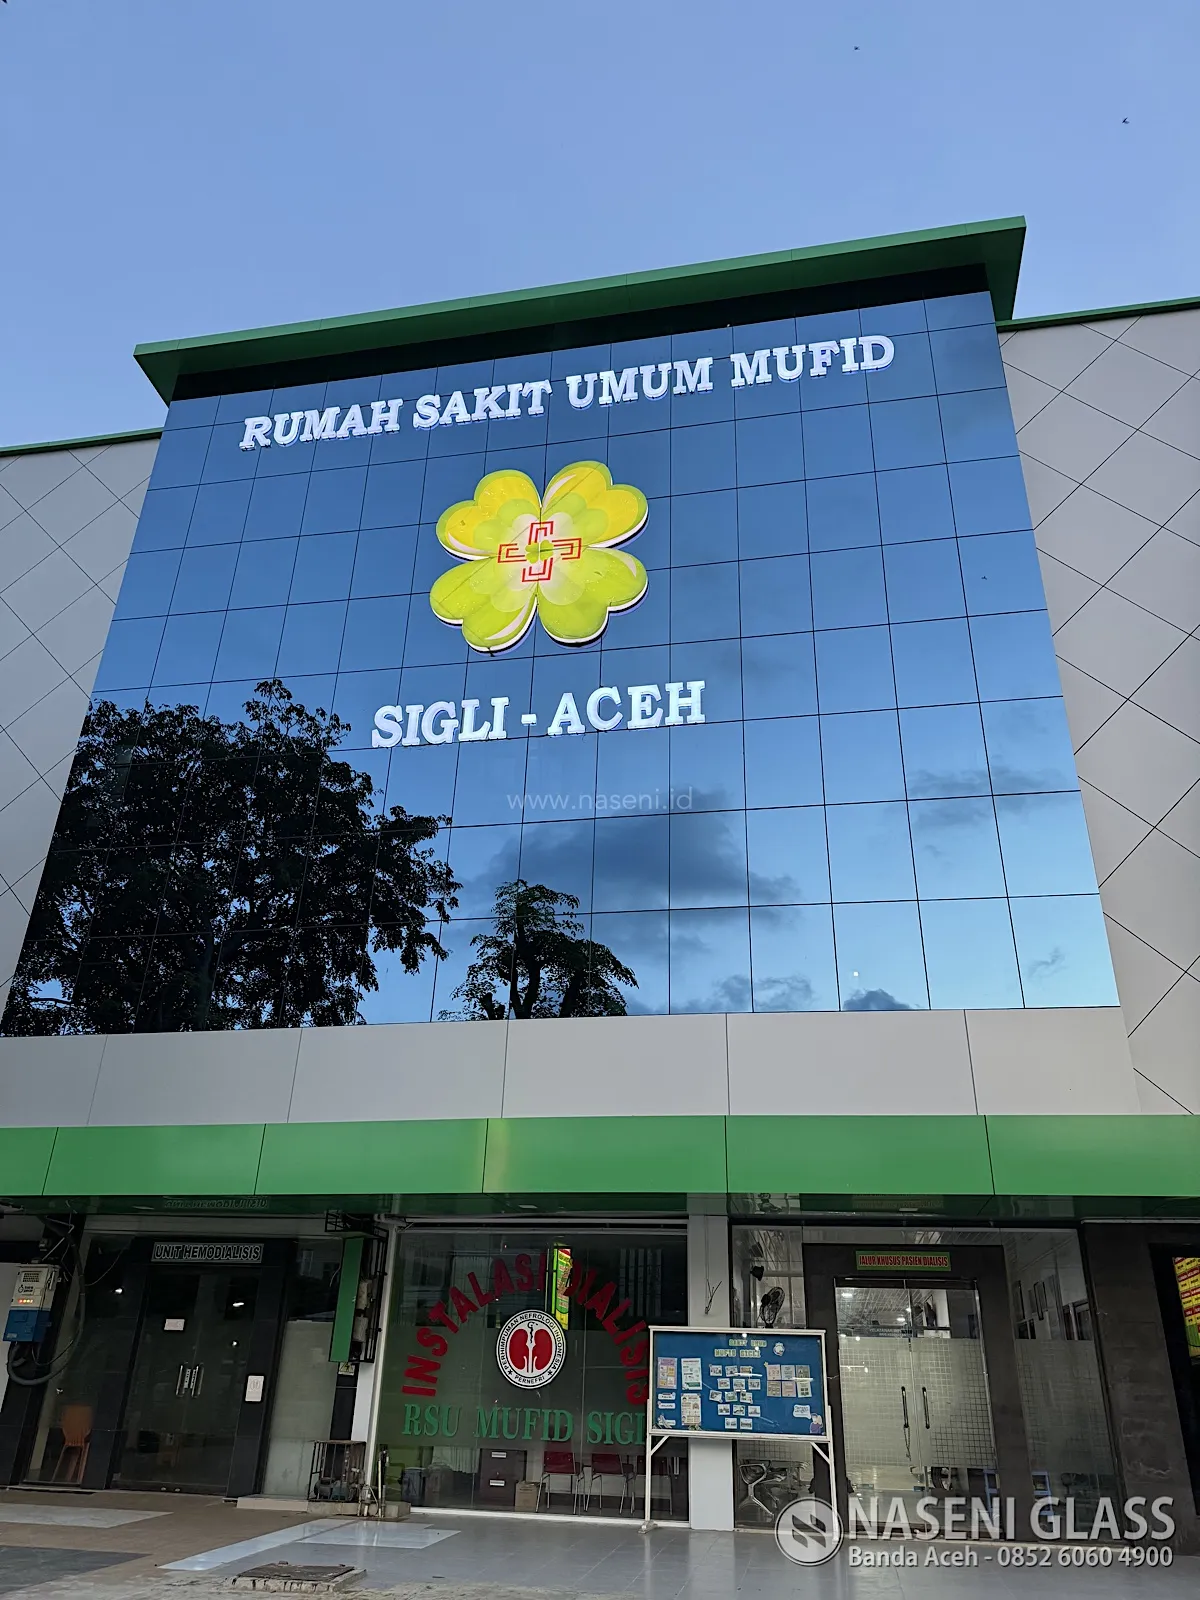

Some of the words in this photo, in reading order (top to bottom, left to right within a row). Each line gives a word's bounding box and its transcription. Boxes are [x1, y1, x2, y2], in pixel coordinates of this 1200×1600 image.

[239, 398, 403, 451] RUMAH
[412, 379, 553, 430] SAKIT
[566, 356, 714, 410] UMUM
[730, 334, 896, 388] MUFID
[371, 696, 510, 749] SIGLI
[546, 680, 706, 737] ACEH
[155, 1244, 182, 1260] UNIT
[182, 1244, 261, 1261] HEMODIALISIS
[401, 1251, 548, 1397] INSTALASI
[520, 1312, 556, 1330] NEFROLOGI
[551, 1328, 563, 1370] INDONESIA
[514, 1374, 546, 1384] PERNEFRI
[401, 1403, 462, 1438] RSU
[472, 1405, 575, 1443] MUFID
